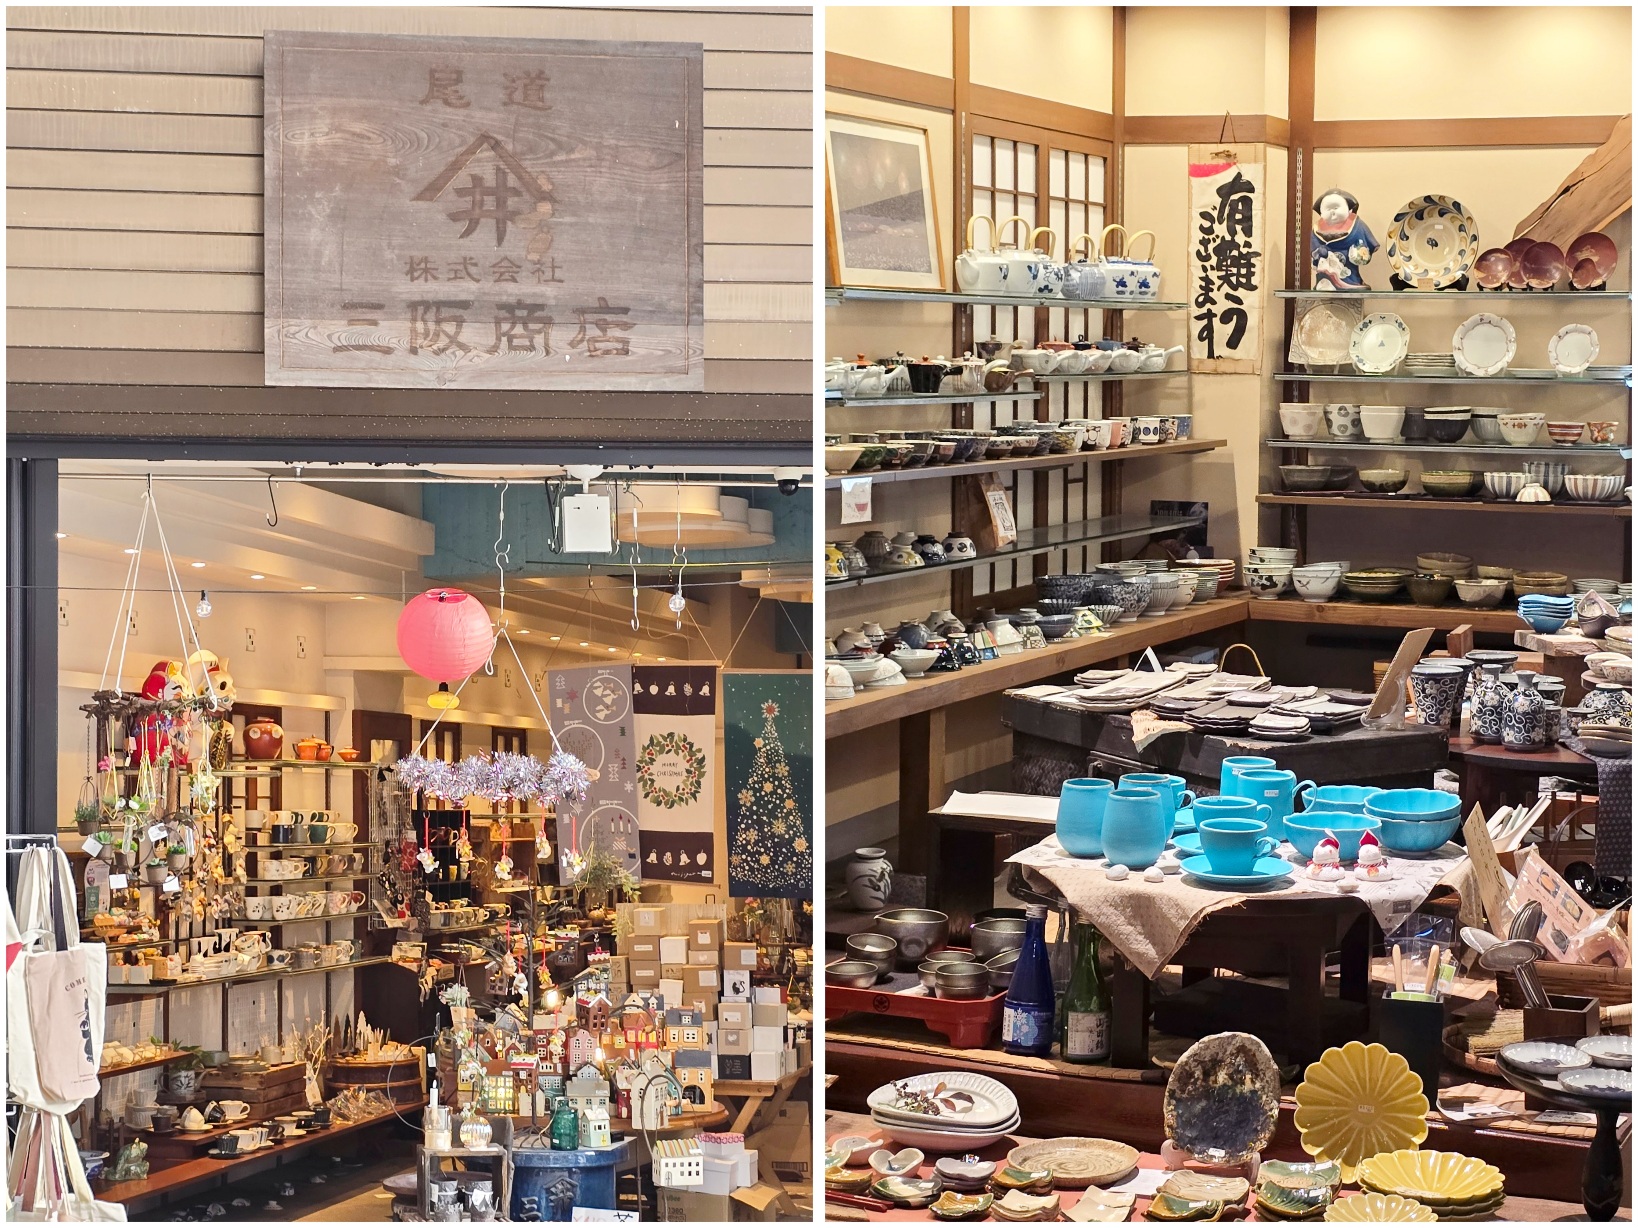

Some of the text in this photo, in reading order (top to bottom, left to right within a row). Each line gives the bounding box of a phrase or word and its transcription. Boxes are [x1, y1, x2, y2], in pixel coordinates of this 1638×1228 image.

[420, 65, 552, 110] 尾道
[403, 255, 566, 285] 株式会社
[1212, 171, 1263, 351] 有難う
[332, 296, 637, 358] 三阪商店
[656, 769, 683, 777] CHRISTMAS
